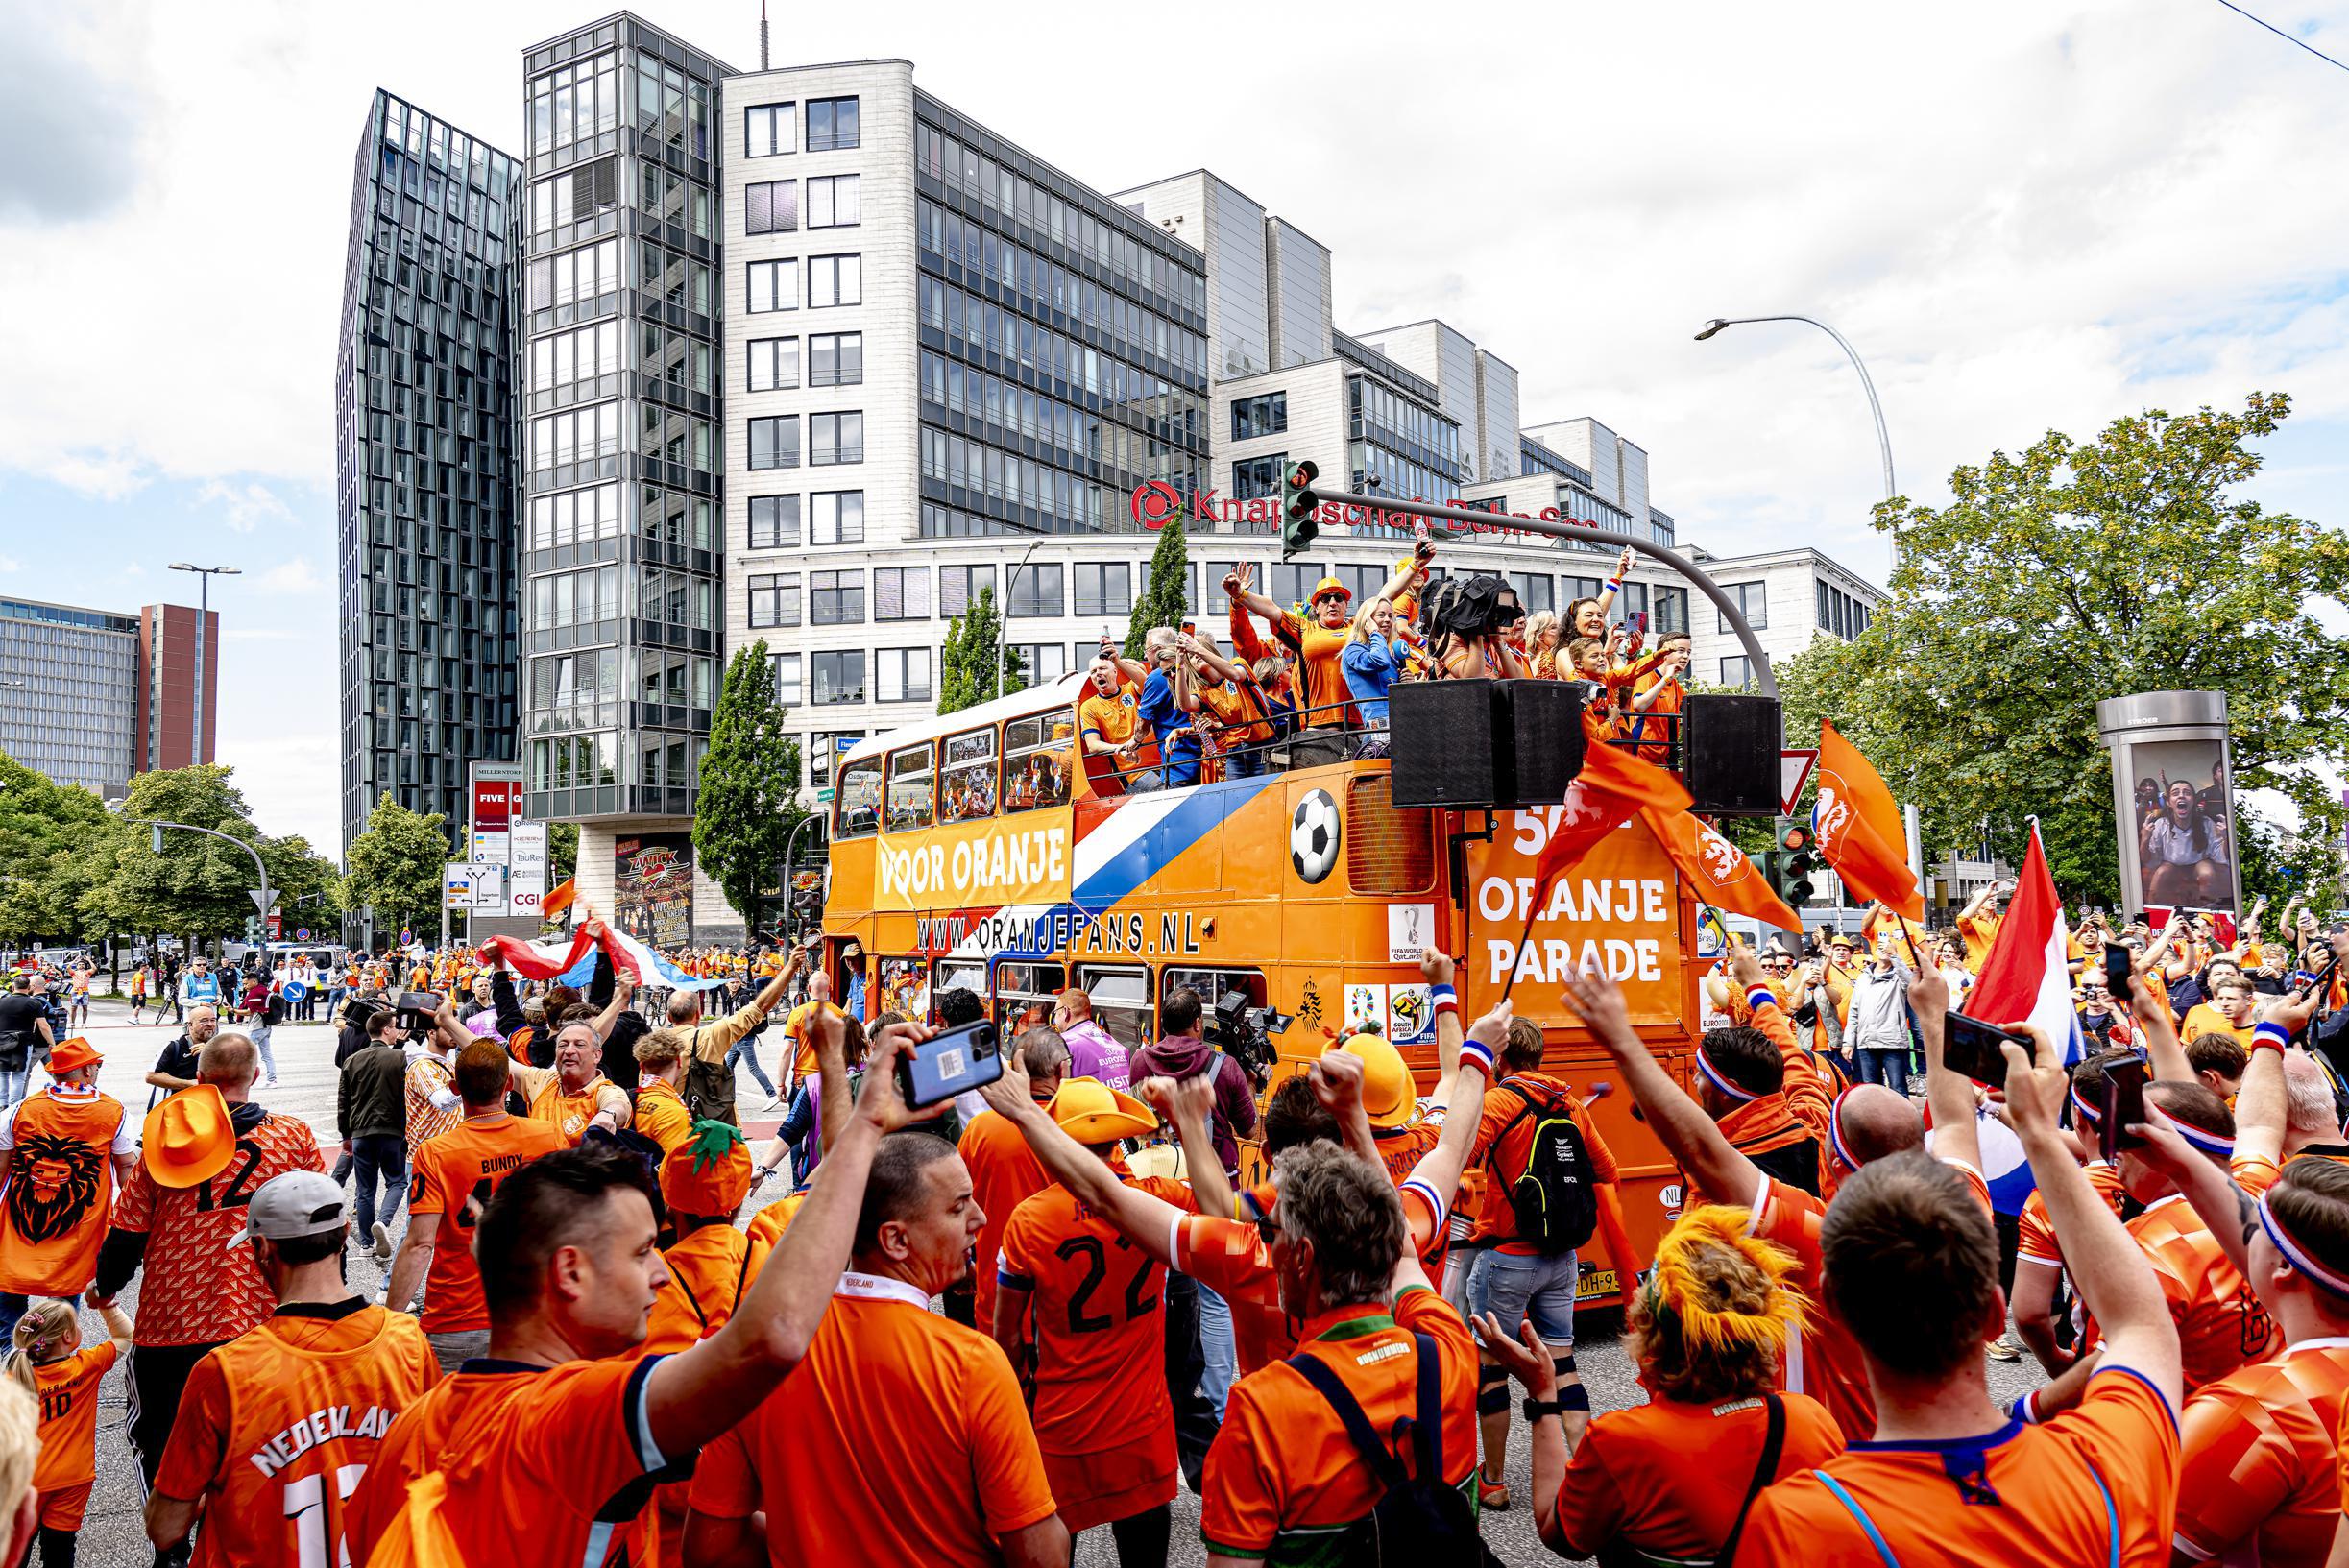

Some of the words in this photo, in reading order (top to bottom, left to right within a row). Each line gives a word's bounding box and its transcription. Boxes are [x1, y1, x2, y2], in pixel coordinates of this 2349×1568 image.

[479, 794, 505, 803] FIVE
[629, 851, 679, 873] ZWICK
[880, 844, 946, 895] VOOR
[952, 828, 1065, 891] ORANJE
[514, 894, 540, 905] CGI
[1478, 876, 1668, 923] ORANJE
[916, 911, 1200, 954] WWW.ORANJEFANS.NL
[1487, 939, 1661, 984] PARADE
[481, 1153, 523, 1174] BUNDY
[1665, 1189, 1682, 1204] NL
[1054, 1235, 1158, 1334] 22
